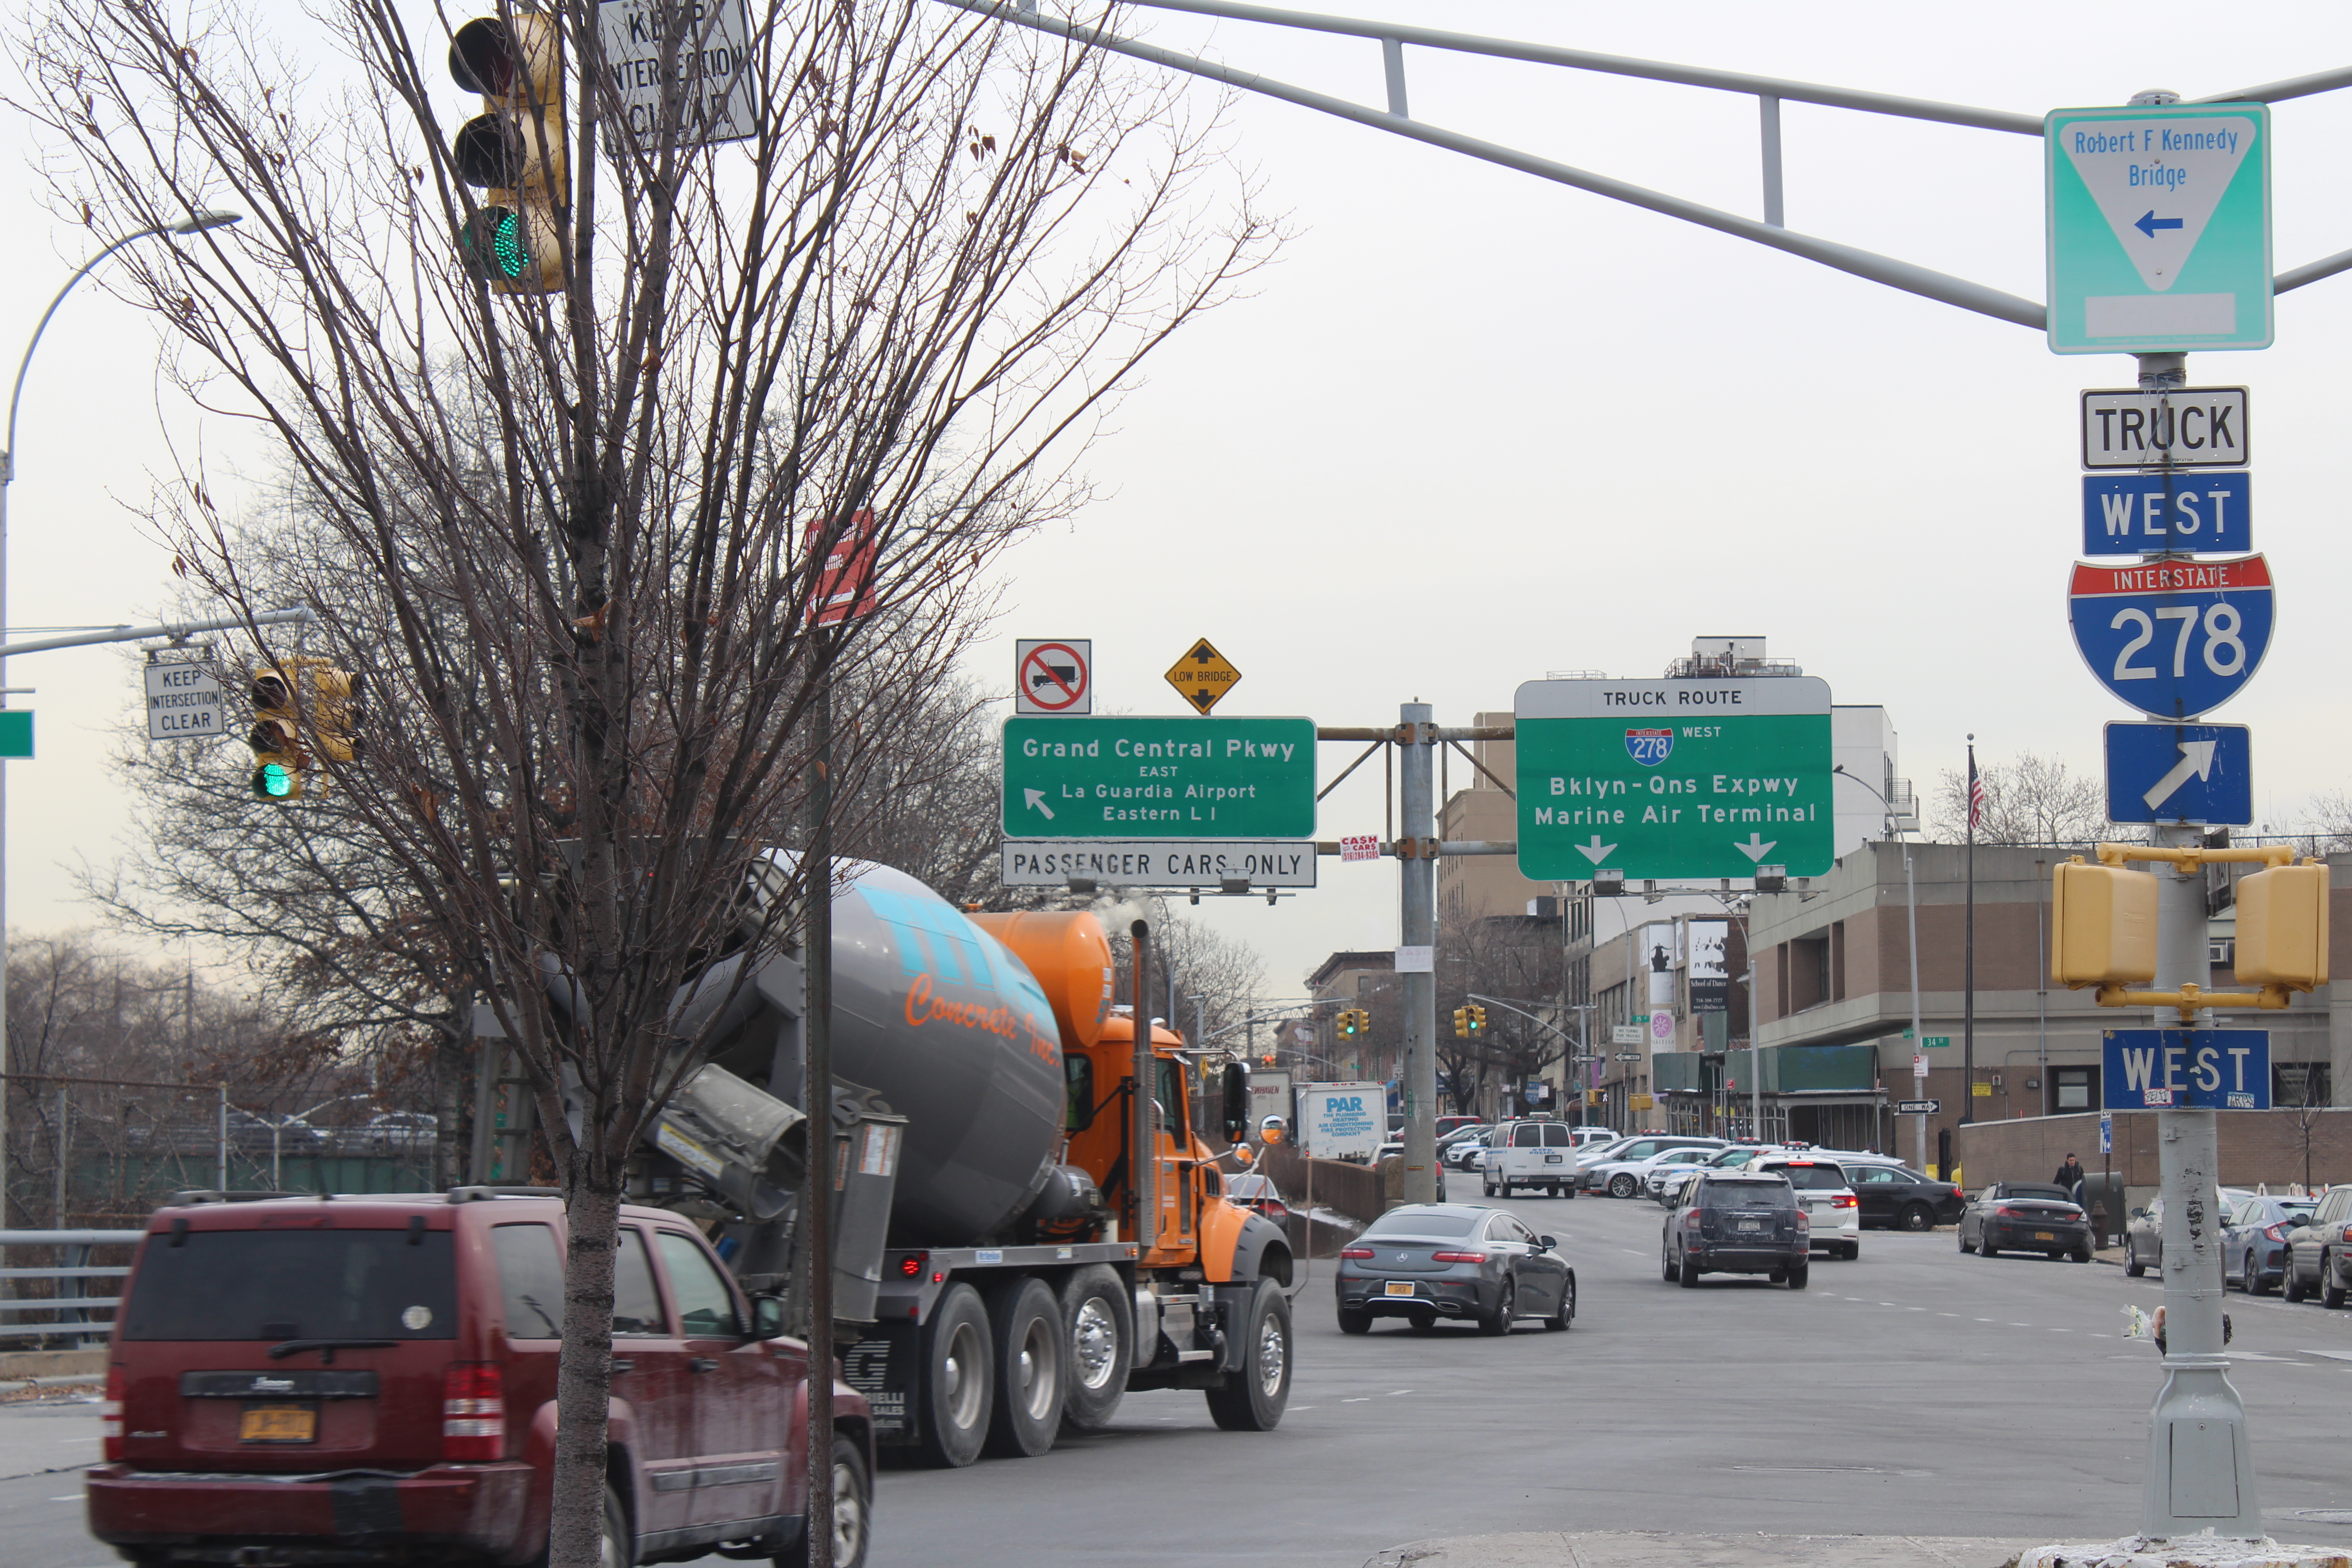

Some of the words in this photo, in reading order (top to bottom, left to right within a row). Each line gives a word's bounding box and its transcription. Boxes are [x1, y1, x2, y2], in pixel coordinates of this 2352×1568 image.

[2075, 130, 2134, 153] Robert
[2144, 129, 2153, 151] F
[2162, 127, 2238, 155] Kennedy
[2129, 164, 2186, 192] Bridge
[2095, 405, 2235, 452] TRUCK
[2101, 490, 2231, 536] WEST
[2113, 567, 2230, 590] INTERSTATE
[2110, 603, 2246, 681] 278
[162, 670, 201, 687] KEEP
[1174, 671, 1193, 682] LOW
[1198, 671, 1232, 682] BRIDGE
[150, 691, 219, 710] INTERSECTION
[1604, 691, 1666, 706] TRUCK
[1679, 690, 1742, 705] ROUTE
[162, 712, 211, 731] CLEAR
[1682, 726, 1721, 738] WEST
[1023, 739, 1099, 757] Grand
[1115, 739, 1212, 757] Central
[1226, 739, 1295, 762] Pkwy
[1633, 737, 1667, 759] 278
[1139, 766, 1178, 777] EAST
[1063, 784, 1085, 799] La
[1096, 784, 1173, 799] Guardia
[1185, 784, 1256, 801] Airport
[1713, 774, 1798, 797] Expwy
[1103, 806, 1180, 821] Eastern
[1535, 806, 1625, 825] Marine
[1642, 805, 1682, 823] Air
[1697, 803, 1814, 824] Terminal
[1014, 853, 1150, 875] PASSENGER
[1168, 854, 1226, 875] CARS
[1245, 854, 1301, 875] ONLY
[905, 973, 1017, 1040] Concrete
[1928, 1038, 1936, 1046] 34
[2122, 1047, 2250, 1092] WEST
[1326, 1096, 1363, 1112] PAR
